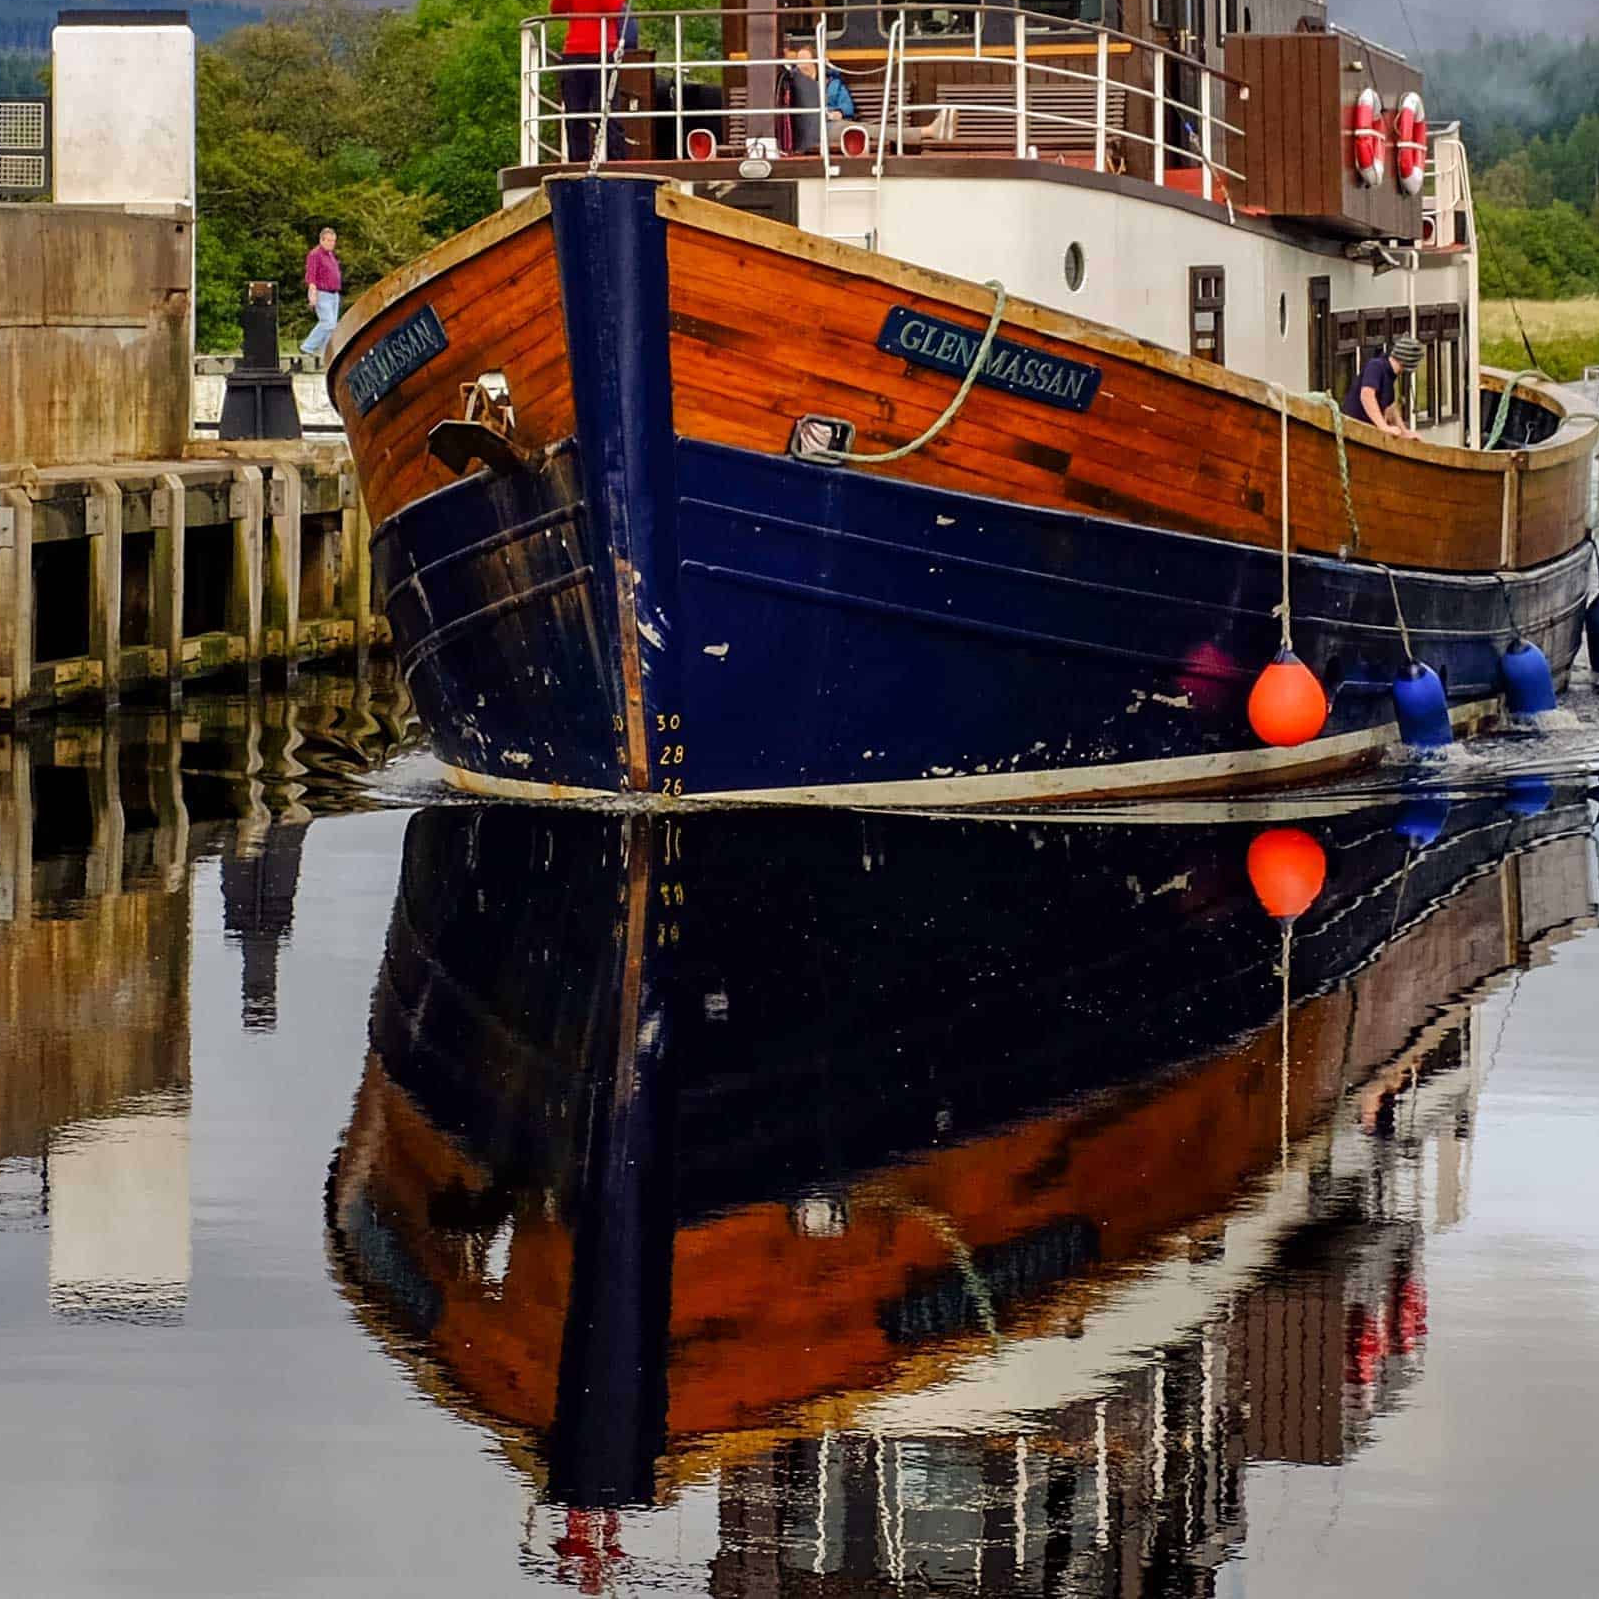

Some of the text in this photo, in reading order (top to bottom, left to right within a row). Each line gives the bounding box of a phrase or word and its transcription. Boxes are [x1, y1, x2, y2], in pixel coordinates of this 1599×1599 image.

[374, 317, 435, 379] MASSAN
[899, 319, 1087, 400] GLEN MASSAN
[656, 713, 681, 732] 30
[659, 744, 685, 766] 28
[661, 777, 683, 796] 26
